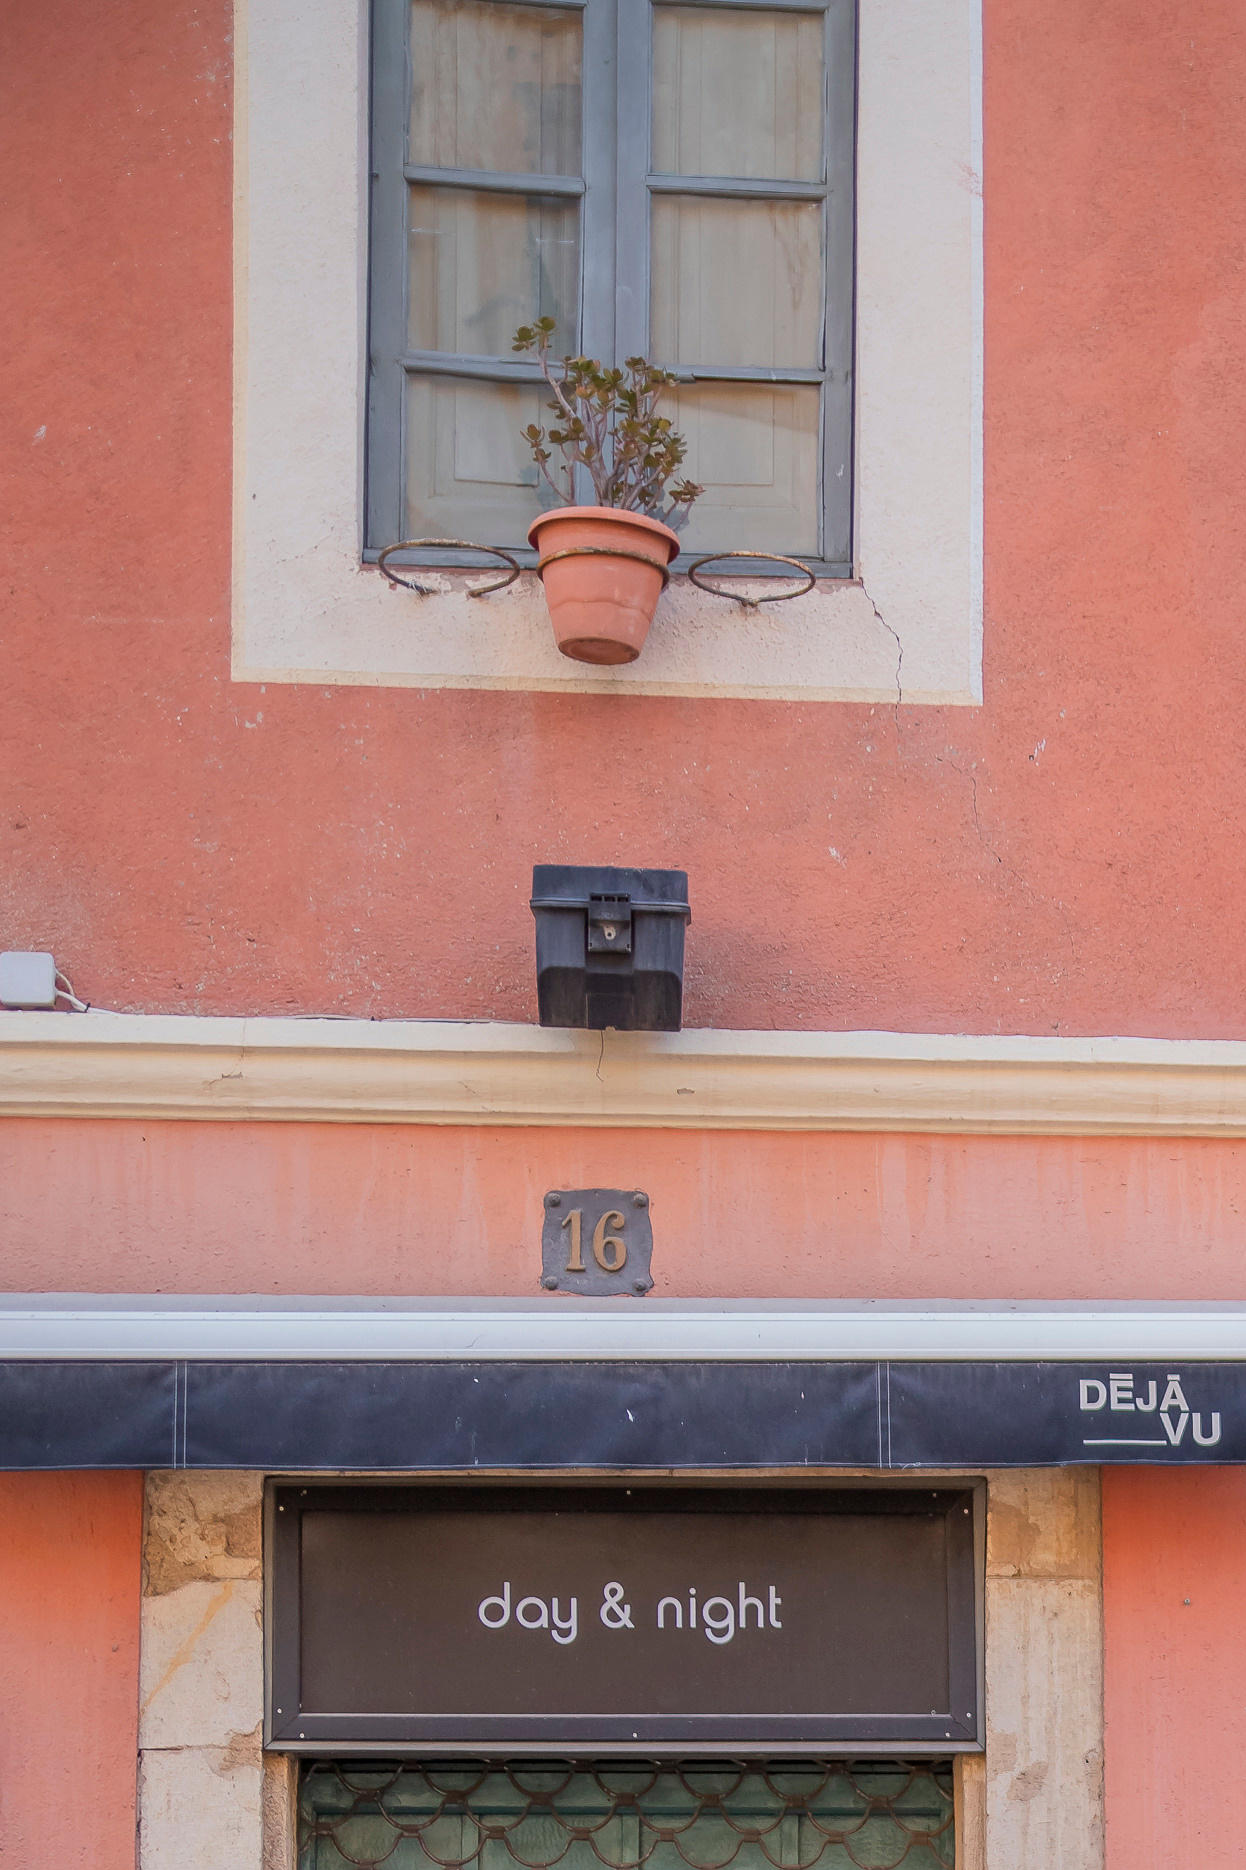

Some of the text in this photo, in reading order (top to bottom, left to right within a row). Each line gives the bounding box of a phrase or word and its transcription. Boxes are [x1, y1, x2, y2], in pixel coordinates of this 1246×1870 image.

[561, 1209, 627, 1271] 16
[1159, 1412, 1222, 1447] VU
[478, 1581, 782, 1645] day & night
